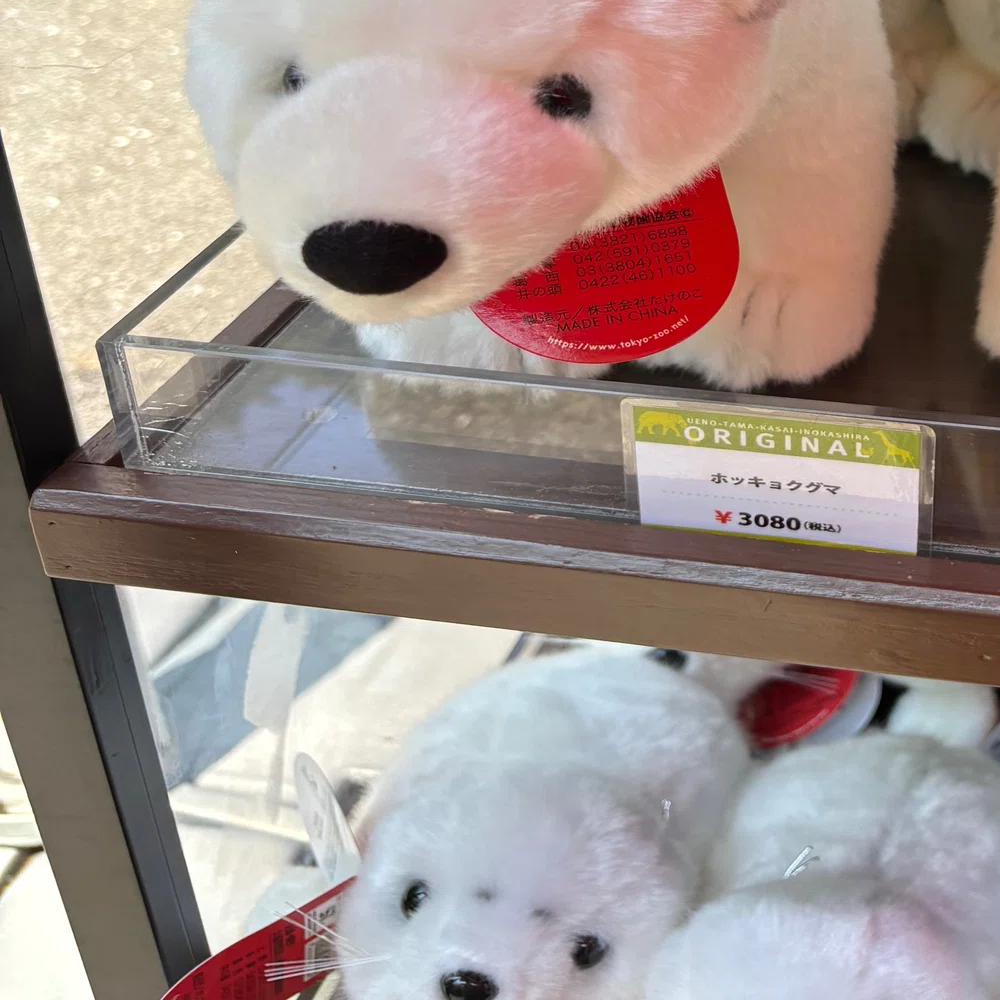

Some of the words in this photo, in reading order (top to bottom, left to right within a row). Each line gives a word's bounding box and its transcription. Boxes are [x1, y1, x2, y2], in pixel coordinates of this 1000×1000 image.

[573, 238, 690, 264] 042(591)0379
[576, 251, 691, 277] 03(3804)1651
[517, 284, 562, 300] 井の頭
[579, 263, 696, 290] 0422(46)1100
[547, 315, 689, 350] https://www.tokyo-zoo.net/
[557, 317, 600, 333] MADE
[606, 314, 623, 325] IN
[628, 305, 679, 321] CHINA
[684, 426, 870, 458] ORIGINAL
[711, 472, 841, 495] ホッキョクグマ
